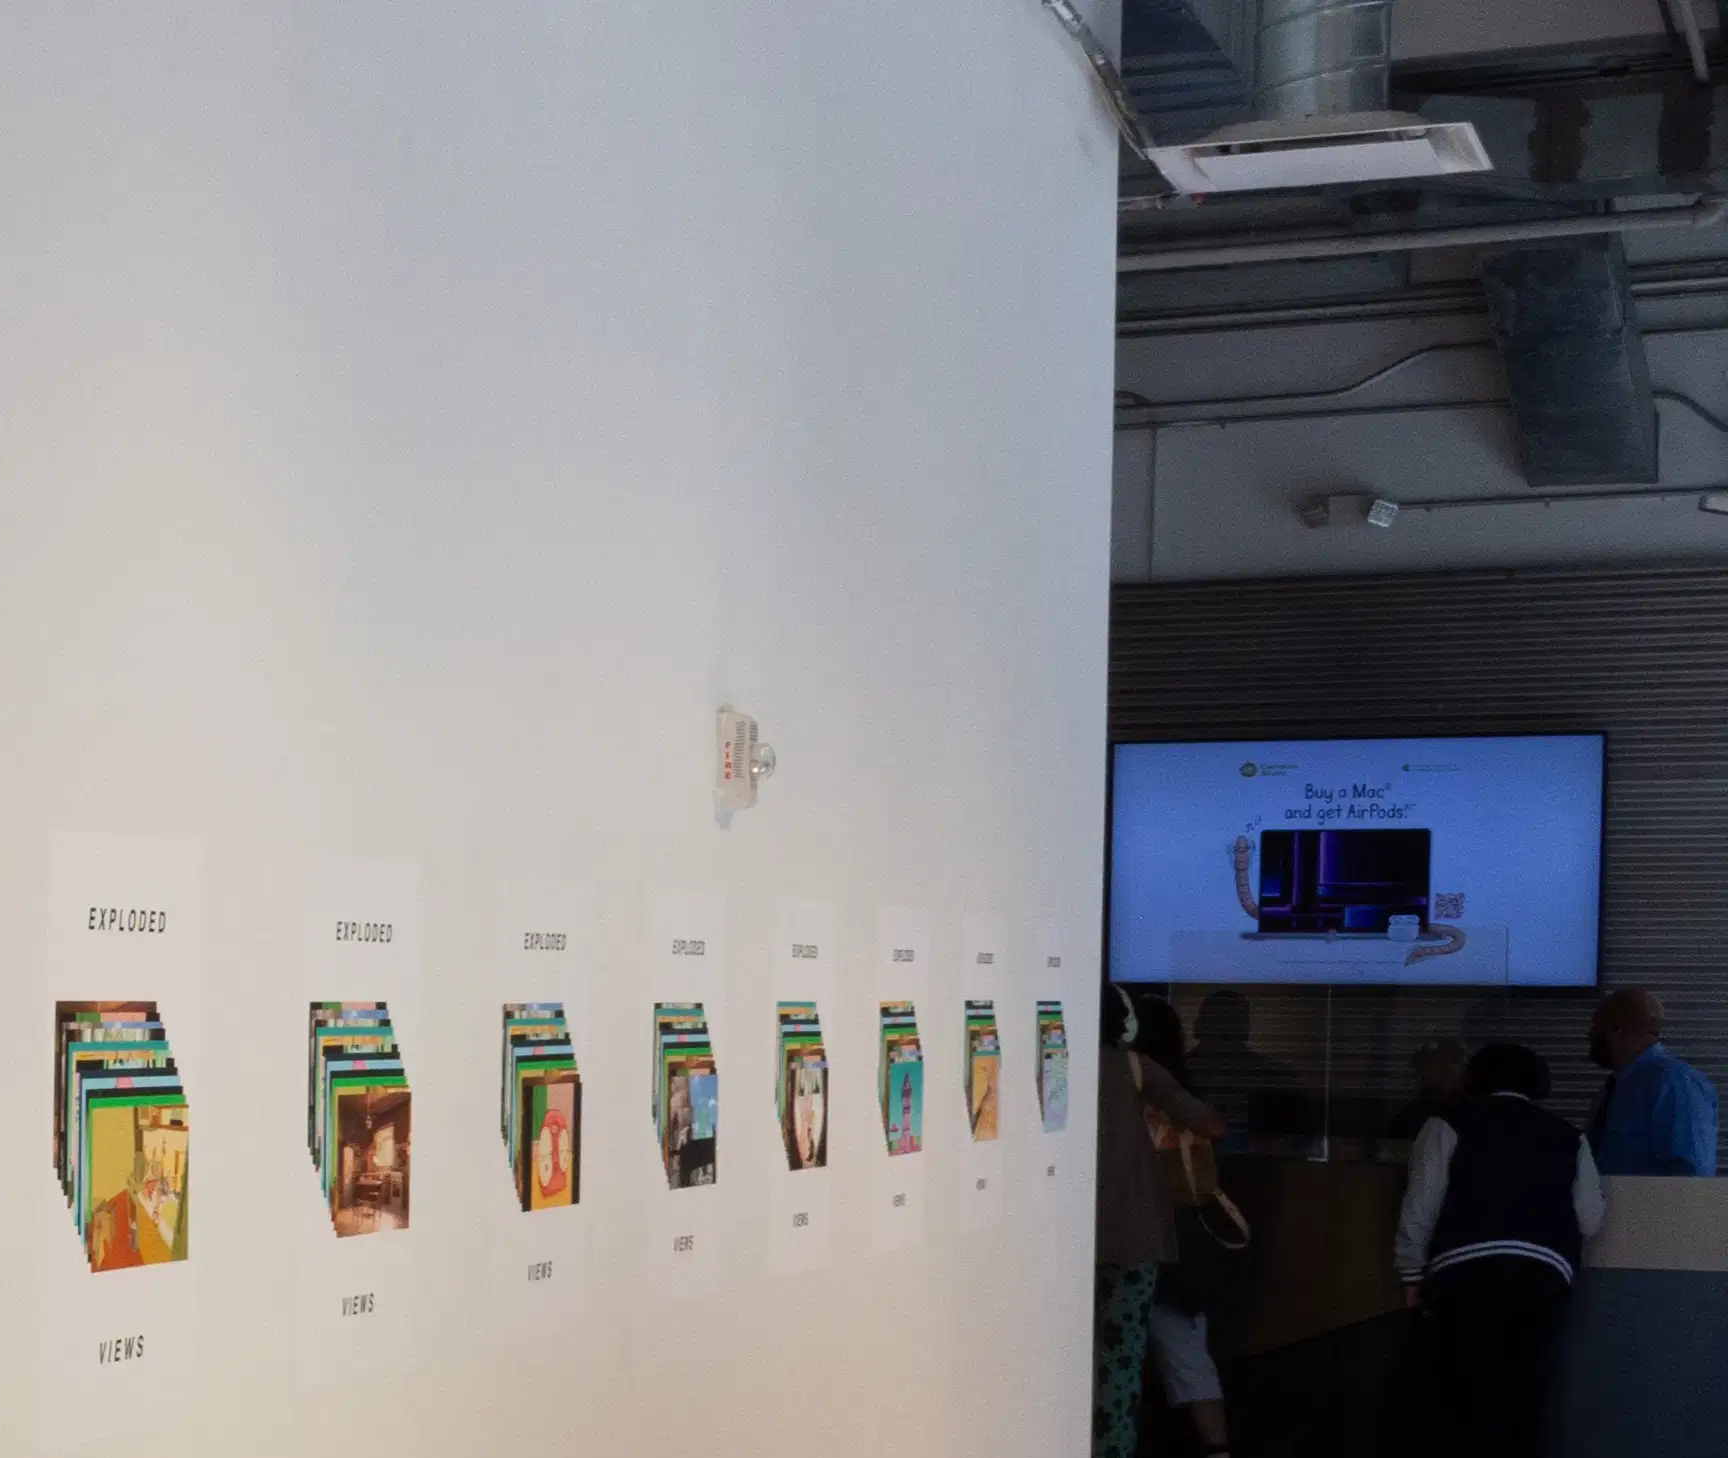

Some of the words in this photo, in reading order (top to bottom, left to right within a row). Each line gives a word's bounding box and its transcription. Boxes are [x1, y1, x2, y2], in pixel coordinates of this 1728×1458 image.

[1304, 783, 1333, 803] Buy
[1338, 788, 1347, 799] a
[1285, 804, 1312, 820] and
[1317, 805, 1342, 825] get
[88, 907, 166, 933] EXPLODED
[336, 921, 392, 943] EXPLODED
[523, 932, 567, 951] EXPLODED
[341, 1291, 376, 1317] VIEWS
[99, 1334, 144, 1364] VIEWS
